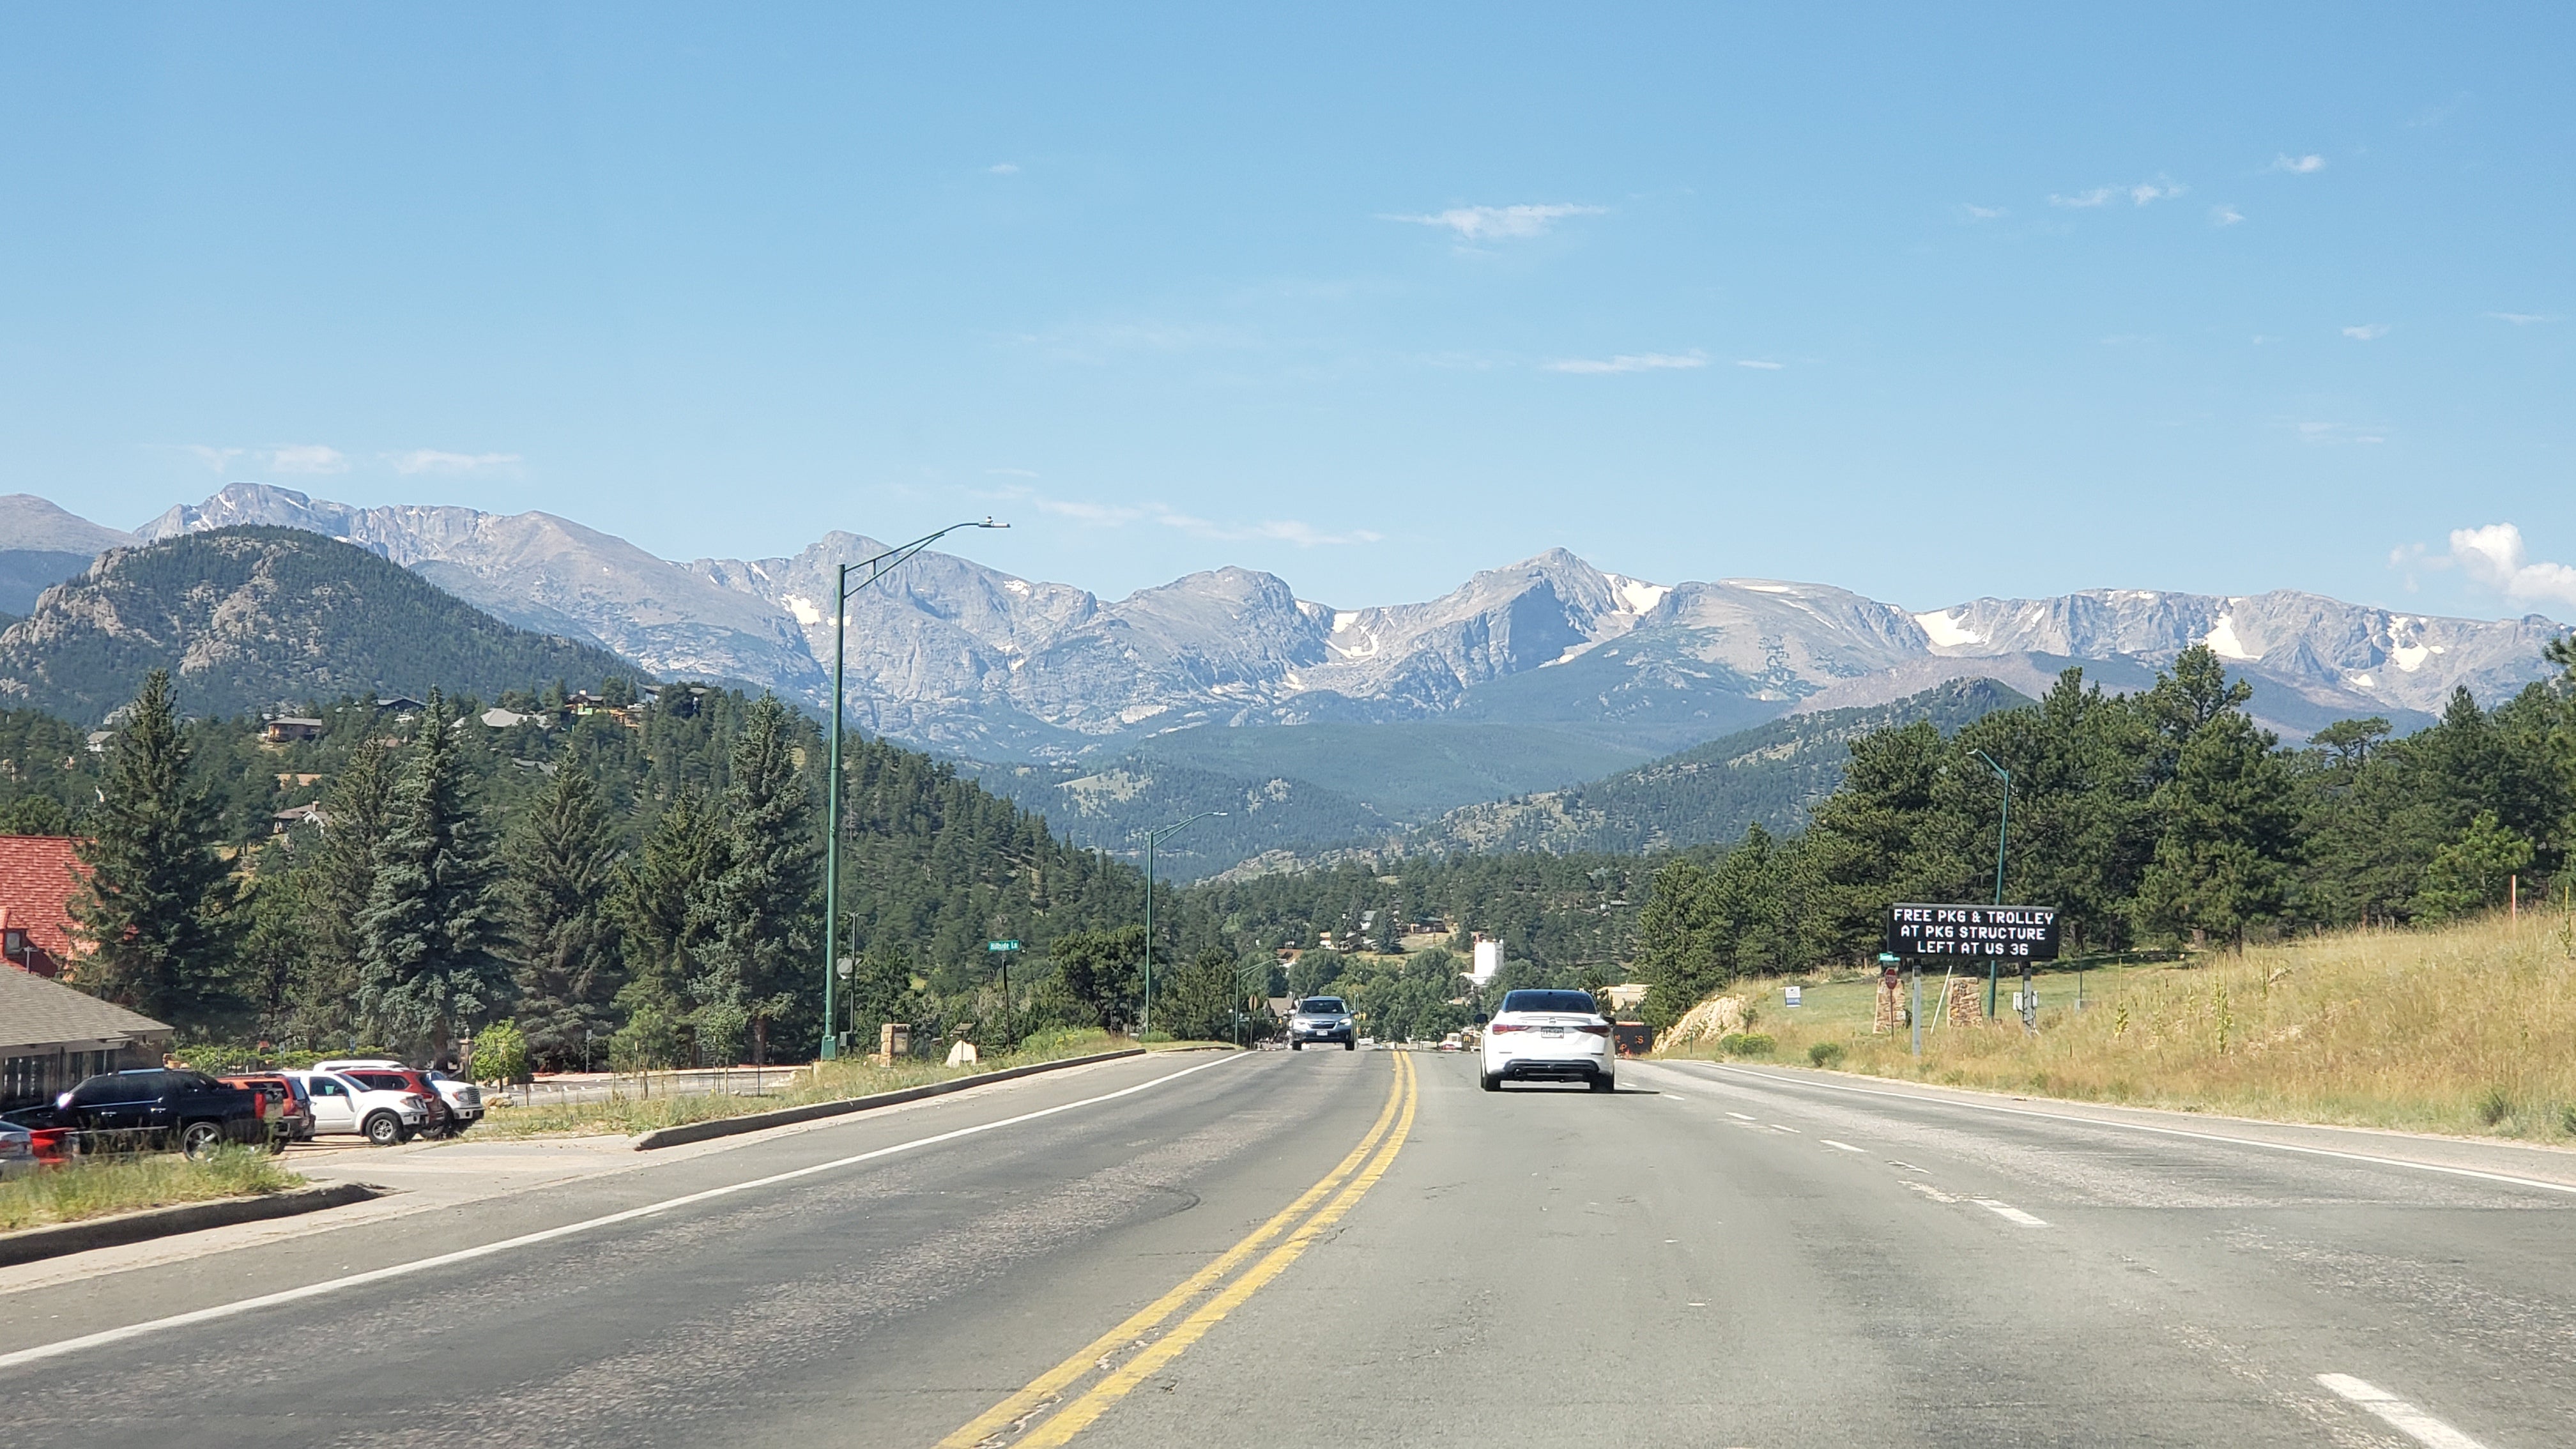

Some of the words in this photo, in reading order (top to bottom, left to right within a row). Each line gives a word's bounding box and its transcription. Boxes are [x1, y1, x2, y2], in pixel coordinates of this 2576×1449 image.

[1894, 908, 1932, 922] FREE
[1938, 909, 1966, 923] PKG
[1971, 910, 1981, 923] &
[1986, 910, 2053, 925] TROLLEY
[1901, 924, 1920, 937] AT
[1925, 925, 1954, 938] PKG
[1959, 926, 2046, 940] STRUCTURE
[1917, 940, 1955, 954] LEFT
[1961, 942, 1980, 954] AT
[1985, 942, 2004, 955] US
[2009, 943, 2028, 956] 36
